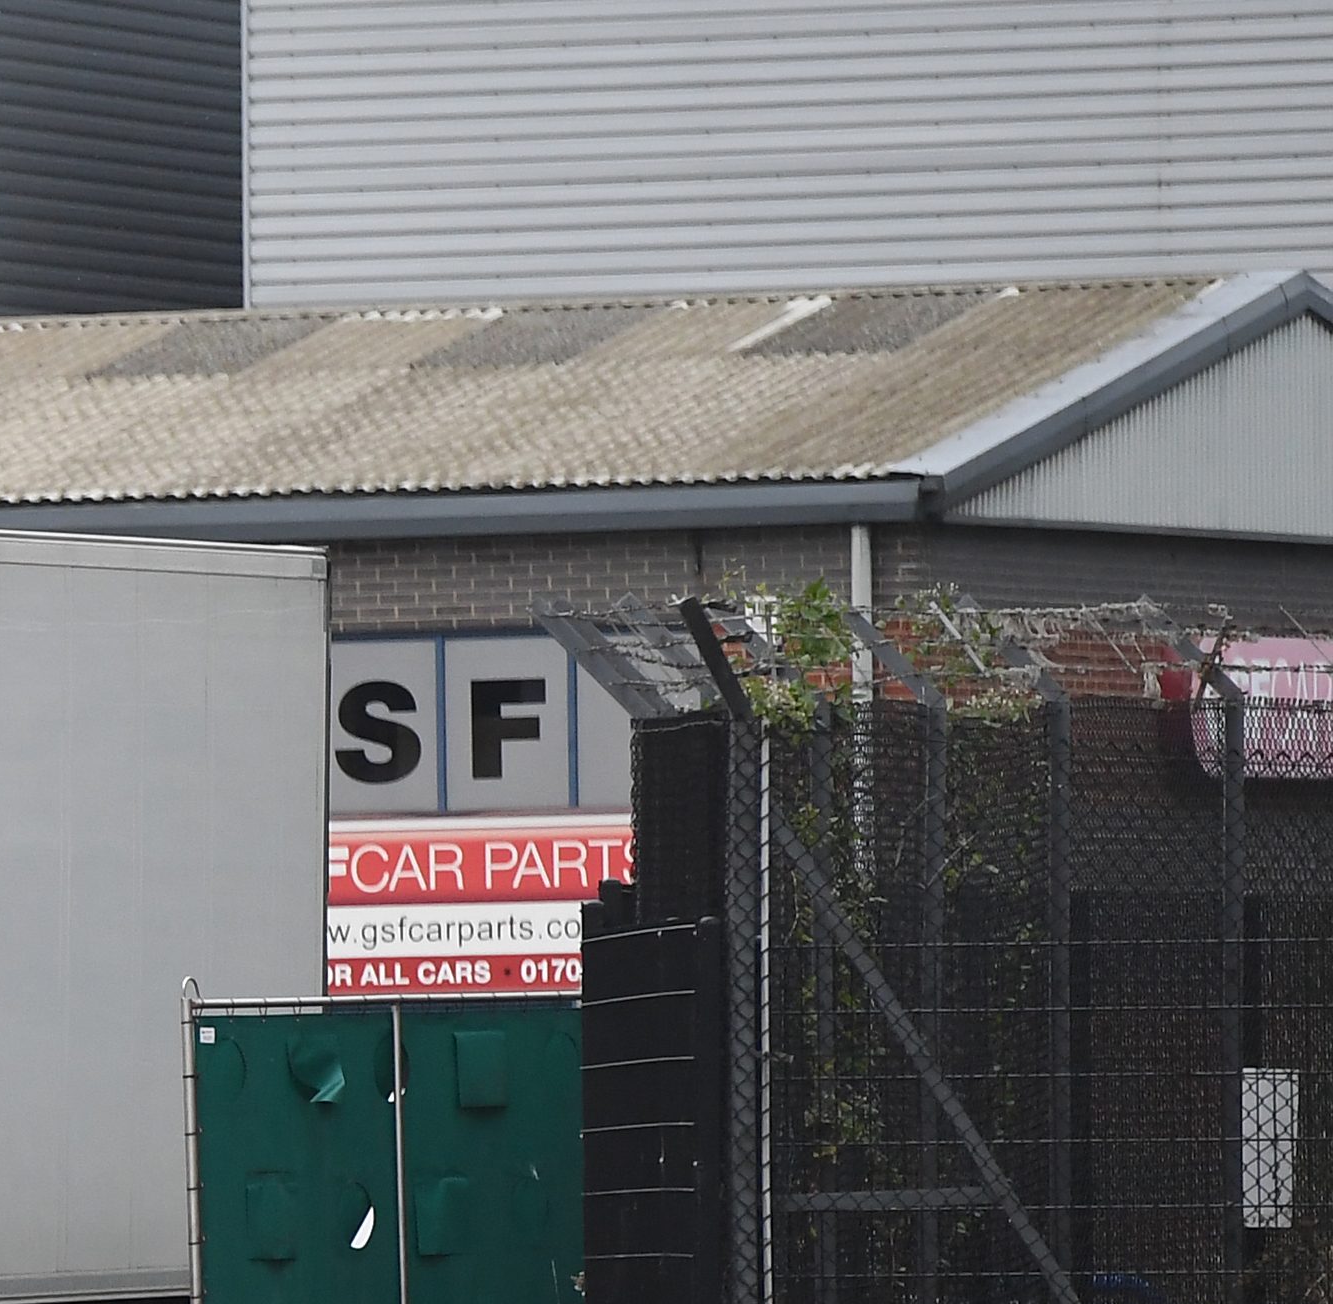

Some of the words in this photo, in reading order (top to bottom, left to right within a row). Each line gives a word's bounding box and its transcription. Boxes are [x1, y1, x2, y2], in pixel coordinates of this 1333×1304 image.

[329, 963, 353, 987] R
[360, 962, 411, 987] ALL
[417, 959, 492, 986] CARS
